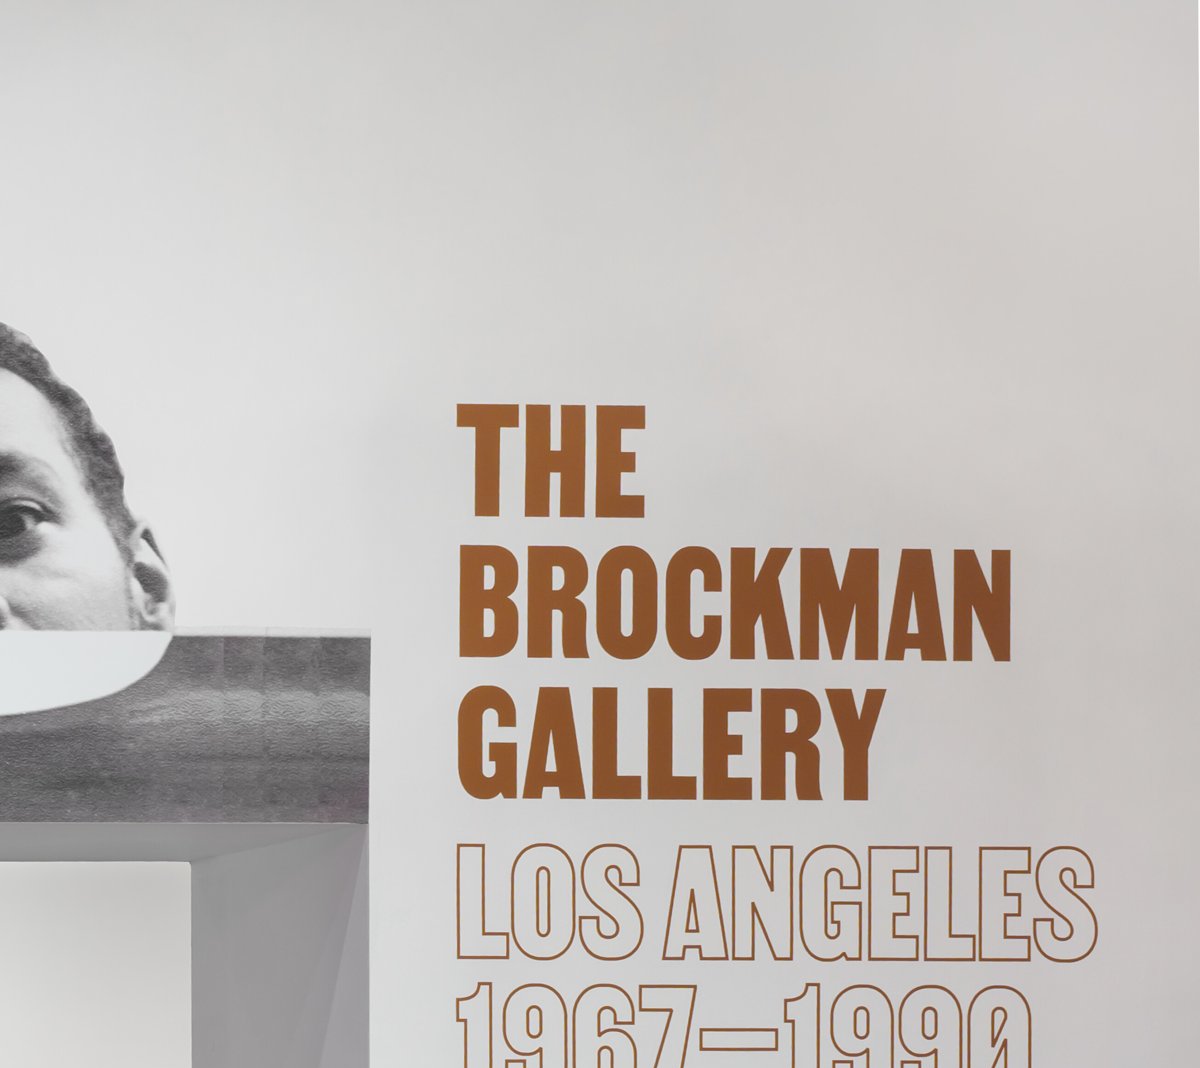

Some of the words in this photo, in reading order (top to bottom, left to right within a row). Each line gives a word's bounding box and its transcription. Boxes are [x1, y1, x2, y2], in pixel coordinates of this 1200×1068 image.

[456, 403, 646, 518] THE
[459, 544, 1012, 662] BROCKMAN
[457, 685, 887, 800] GALLERY
[456, 843, 644, 961] LOS
[661, 844, 1099, 963] ANGELES
